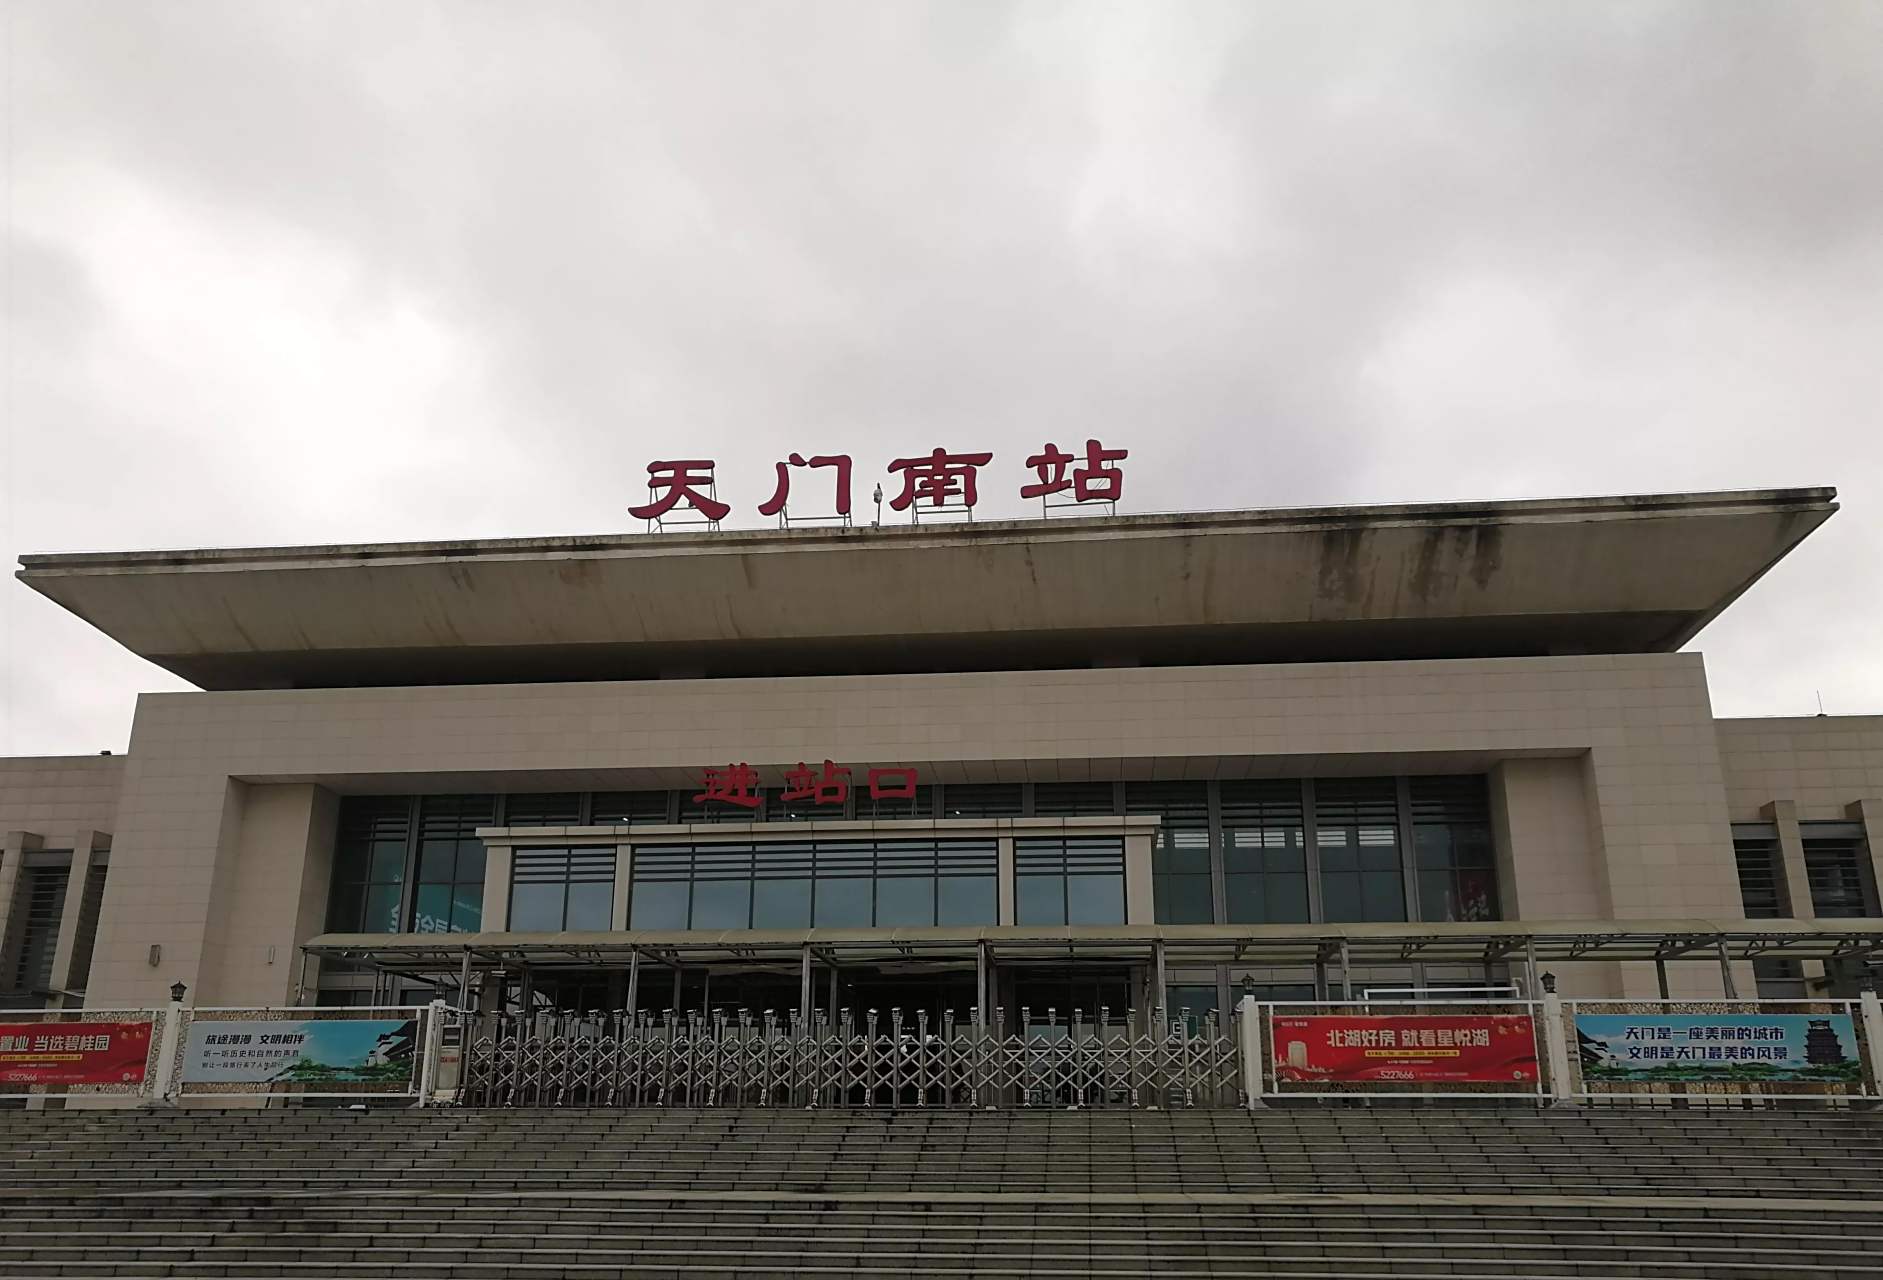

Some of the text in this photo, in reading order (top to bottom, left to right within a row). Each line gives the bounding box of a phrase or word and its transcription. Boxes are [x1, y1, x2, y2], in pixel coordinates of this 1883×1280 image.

[628, 439, 1128, 520] 天门南站
[693, 760, 918, 808] 进站口
[205, 1034, 305, 1045] 旅途漫漫 文明相伴
[1326, 1029, 1490, 1048] 北湖好房 就看星悦湖
[1625, 1026, 1785, 1041] 天门是一座美丽的城市
[33, 1034, 110, 1051] 当选碧桂园
[203, 1049, 299, 1058] 听一听历史和自然的声音
[1627, 1045, 1788, 1060] 文明是天门最美的风景
[1380, 1070, 1415, 1080] 5227666
